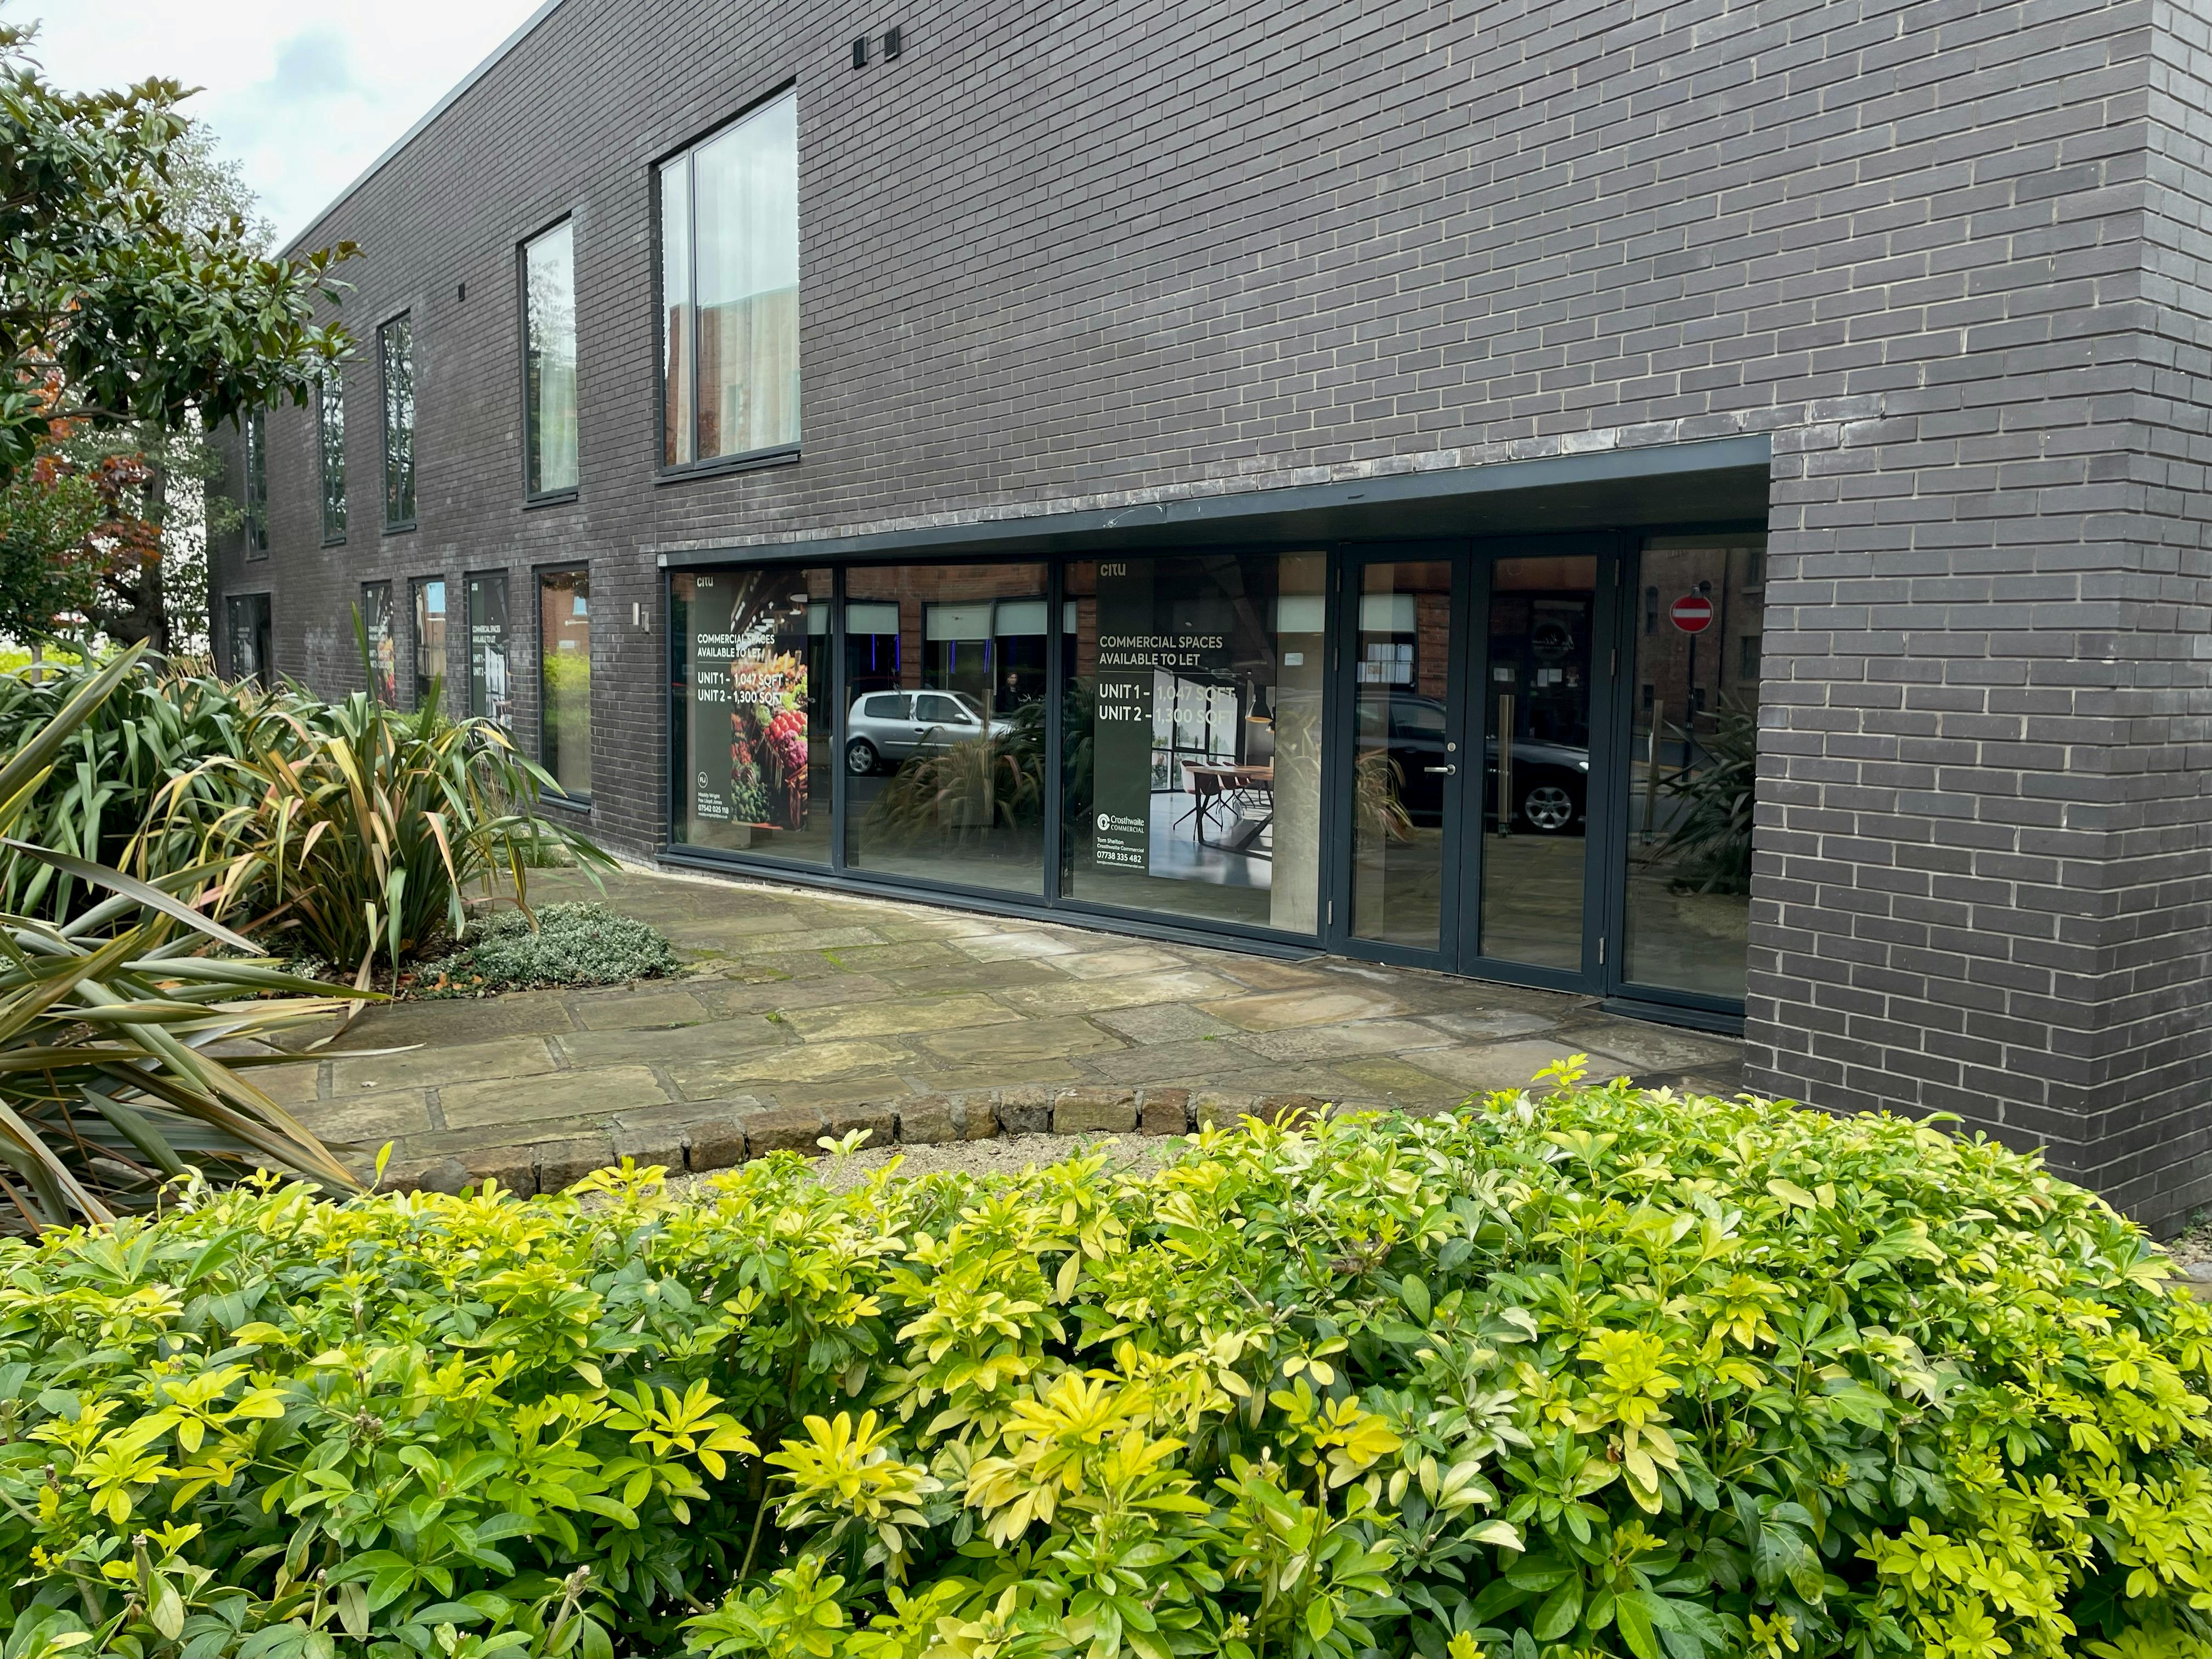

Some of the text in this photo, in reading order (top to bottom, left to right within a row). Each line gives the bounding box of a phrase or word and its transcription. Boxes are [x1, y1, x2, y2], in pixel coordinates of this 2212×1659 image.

[697, 634, 775, 644] COMMERCIAL SPACES
[1099, 636, 1223, 648] COMMERCIAL SPACES
[697, 647, 761, 658] AVAILABLE TO LET
[1099, 653, 1200, 665] AVAILABLE TO LET
[697, 672, 719, 684] UNIT
[719, 673, 724, 684] 1
[734, 673, 757, 686] 1,047
[759, 674, 783, 687] SQFT
[697, 689, 719, 702] UNIT
[720, 690, 725, 702] 2
[733, 691, 757, 704] 1,300
[759, 691, 783, 706] SQFT
[1099, 684, 1131, 698] UNIT
[1133, 685, 1139, 699] 1
[1157, 685, 1193, 702] 1,047
[1196, 687, 1235, 704] SQFT
[1099, 706, 1131, 720] UNIT
[1133, 706, 1142, 721] 2
[1155, 708, 1193, 725] 1,300
[1196, 708, 1234, 725] SQFT
[1110, 815, 1144, 826] Crosthwaite
[1110, 825, 1144, 833] COMMERCIAL
[1097, 850, 1142, 863] 07738 335 482
